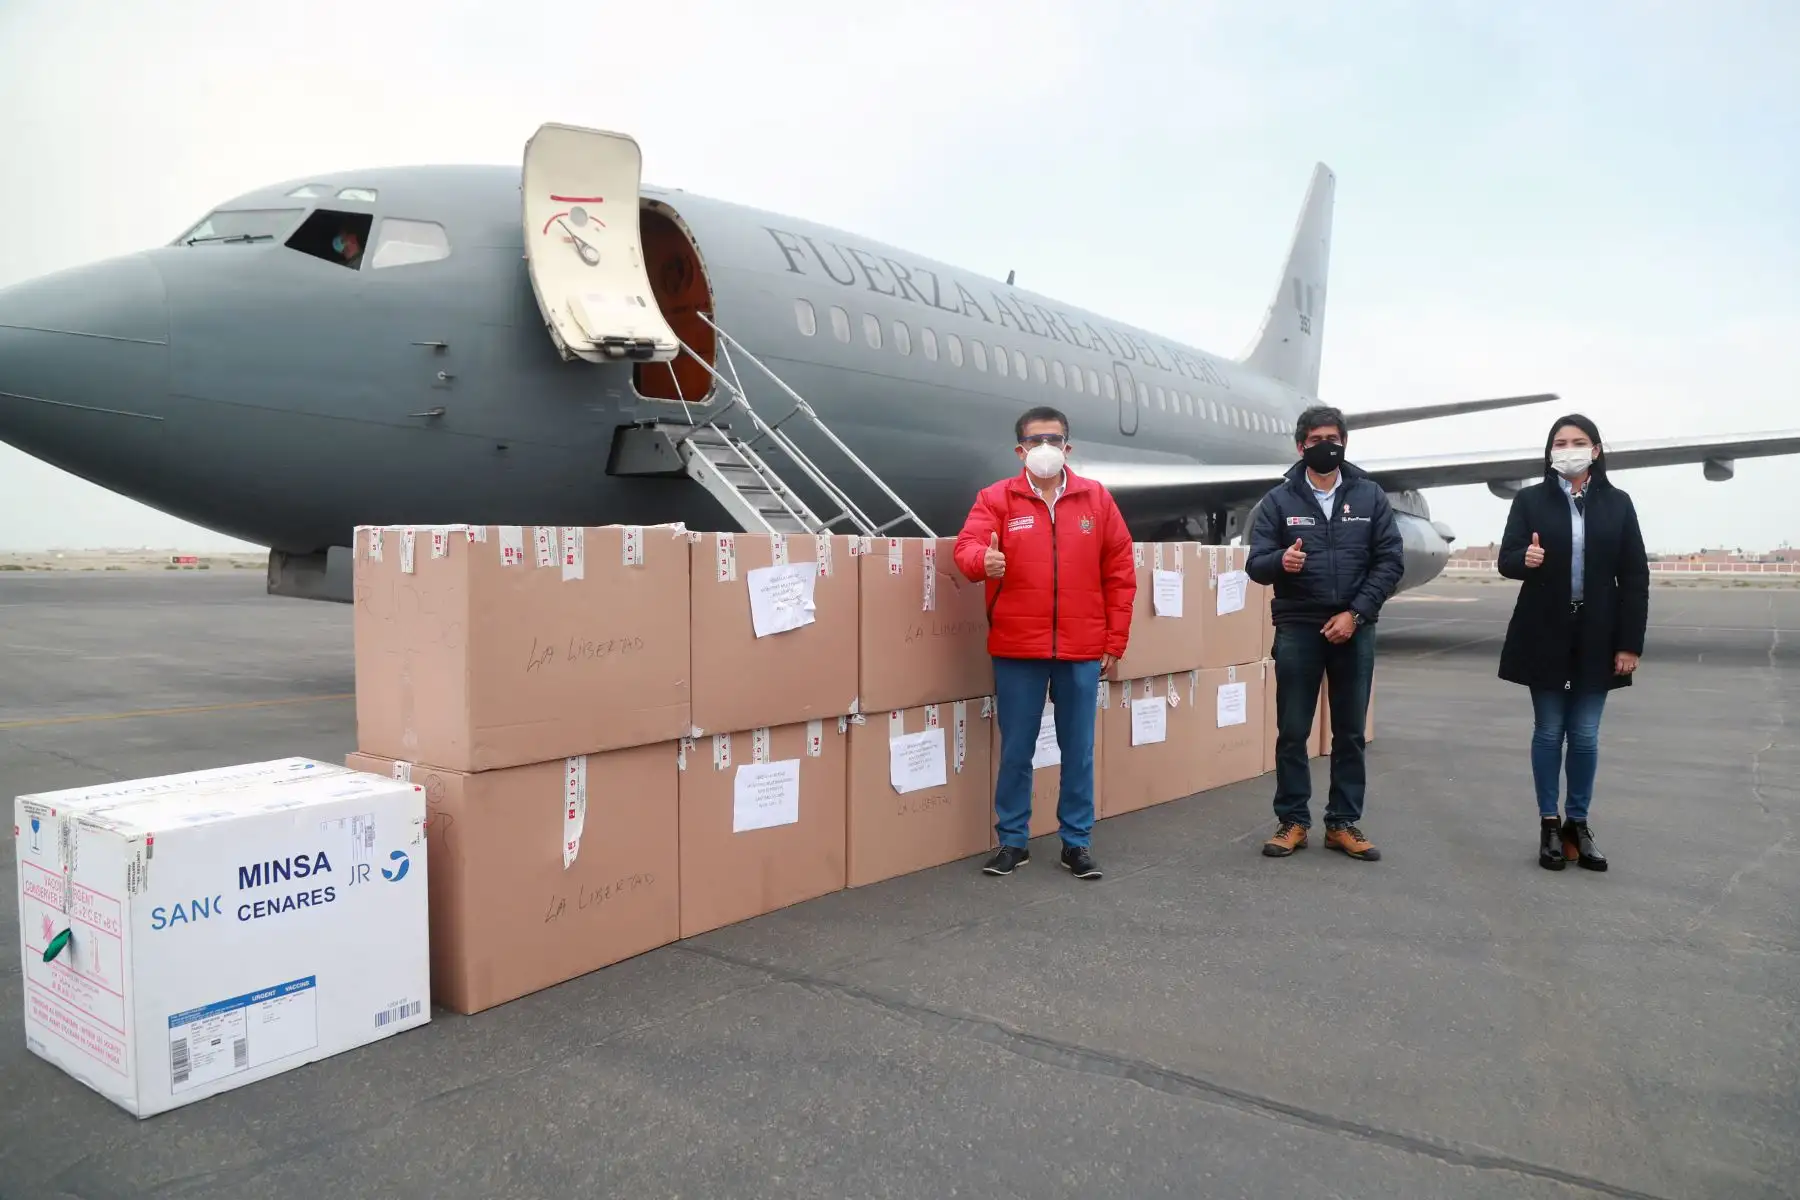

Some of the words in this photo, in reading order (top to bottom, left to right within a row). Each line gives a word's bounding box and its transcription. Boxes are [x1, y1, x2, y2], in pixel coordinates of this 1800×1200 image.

[763, 226, 994, 324] FUERZA
[989, 291, 1115, 356] AEREA
[1104, 325, 1172, 372] DEL
[238, 851, 333, 890] MINSA
[237, 886, 337, 922] CENARES
[251, 989, 277, 1002] URGENT
